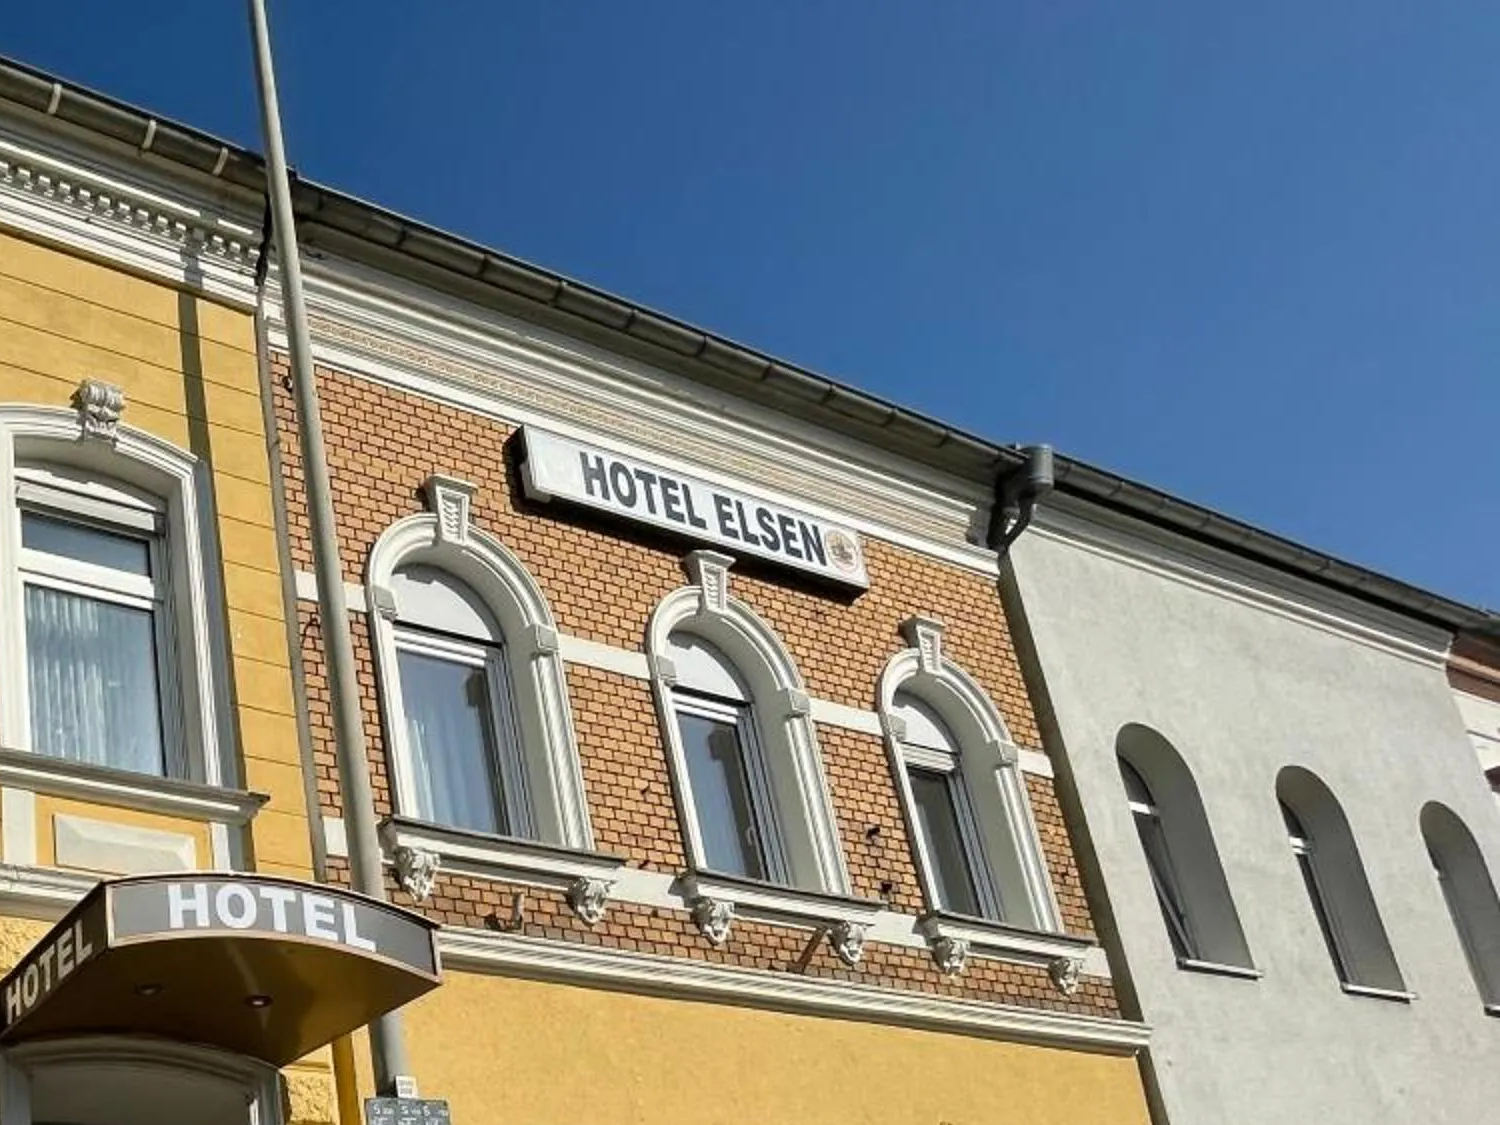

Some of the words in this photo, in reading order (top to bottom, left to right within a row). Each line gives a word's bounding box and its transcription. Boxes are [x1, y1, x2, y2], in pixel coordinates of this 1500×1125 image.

[580, 452, 707, 530] HOTEL
[712, 494, 827, 566] ELSEN
[167, 883, 377, 953] HOTEL
[6, 919, 93, 1025] HOTEL
